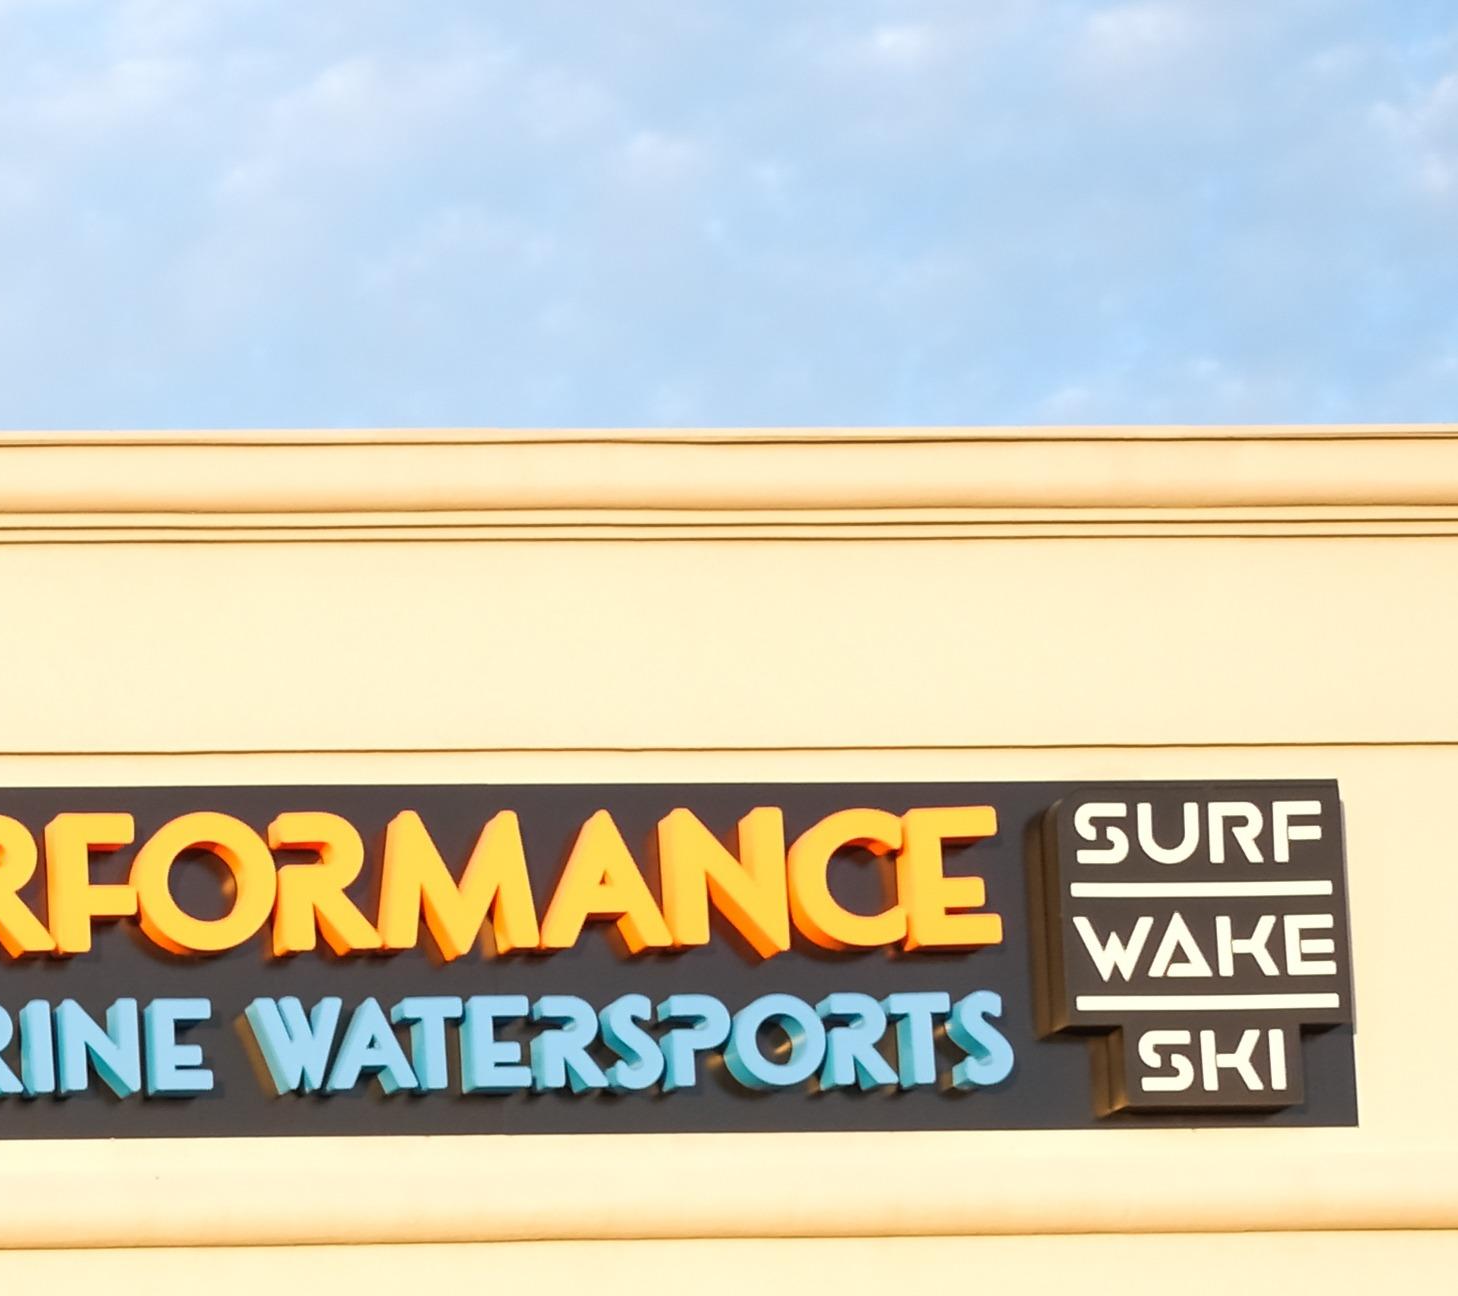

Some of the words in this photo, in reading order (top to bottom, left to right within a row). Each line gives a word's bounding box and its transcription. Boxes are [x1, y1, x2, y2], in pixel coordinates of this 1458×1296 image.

[1075, 801, 1322, 864] SURF
[1073, 912, 1337, 981] WAKE
[244, 991, 1014, 1097] WATERSPORTS
[1138, 1028, 1287, 1091] SKI
